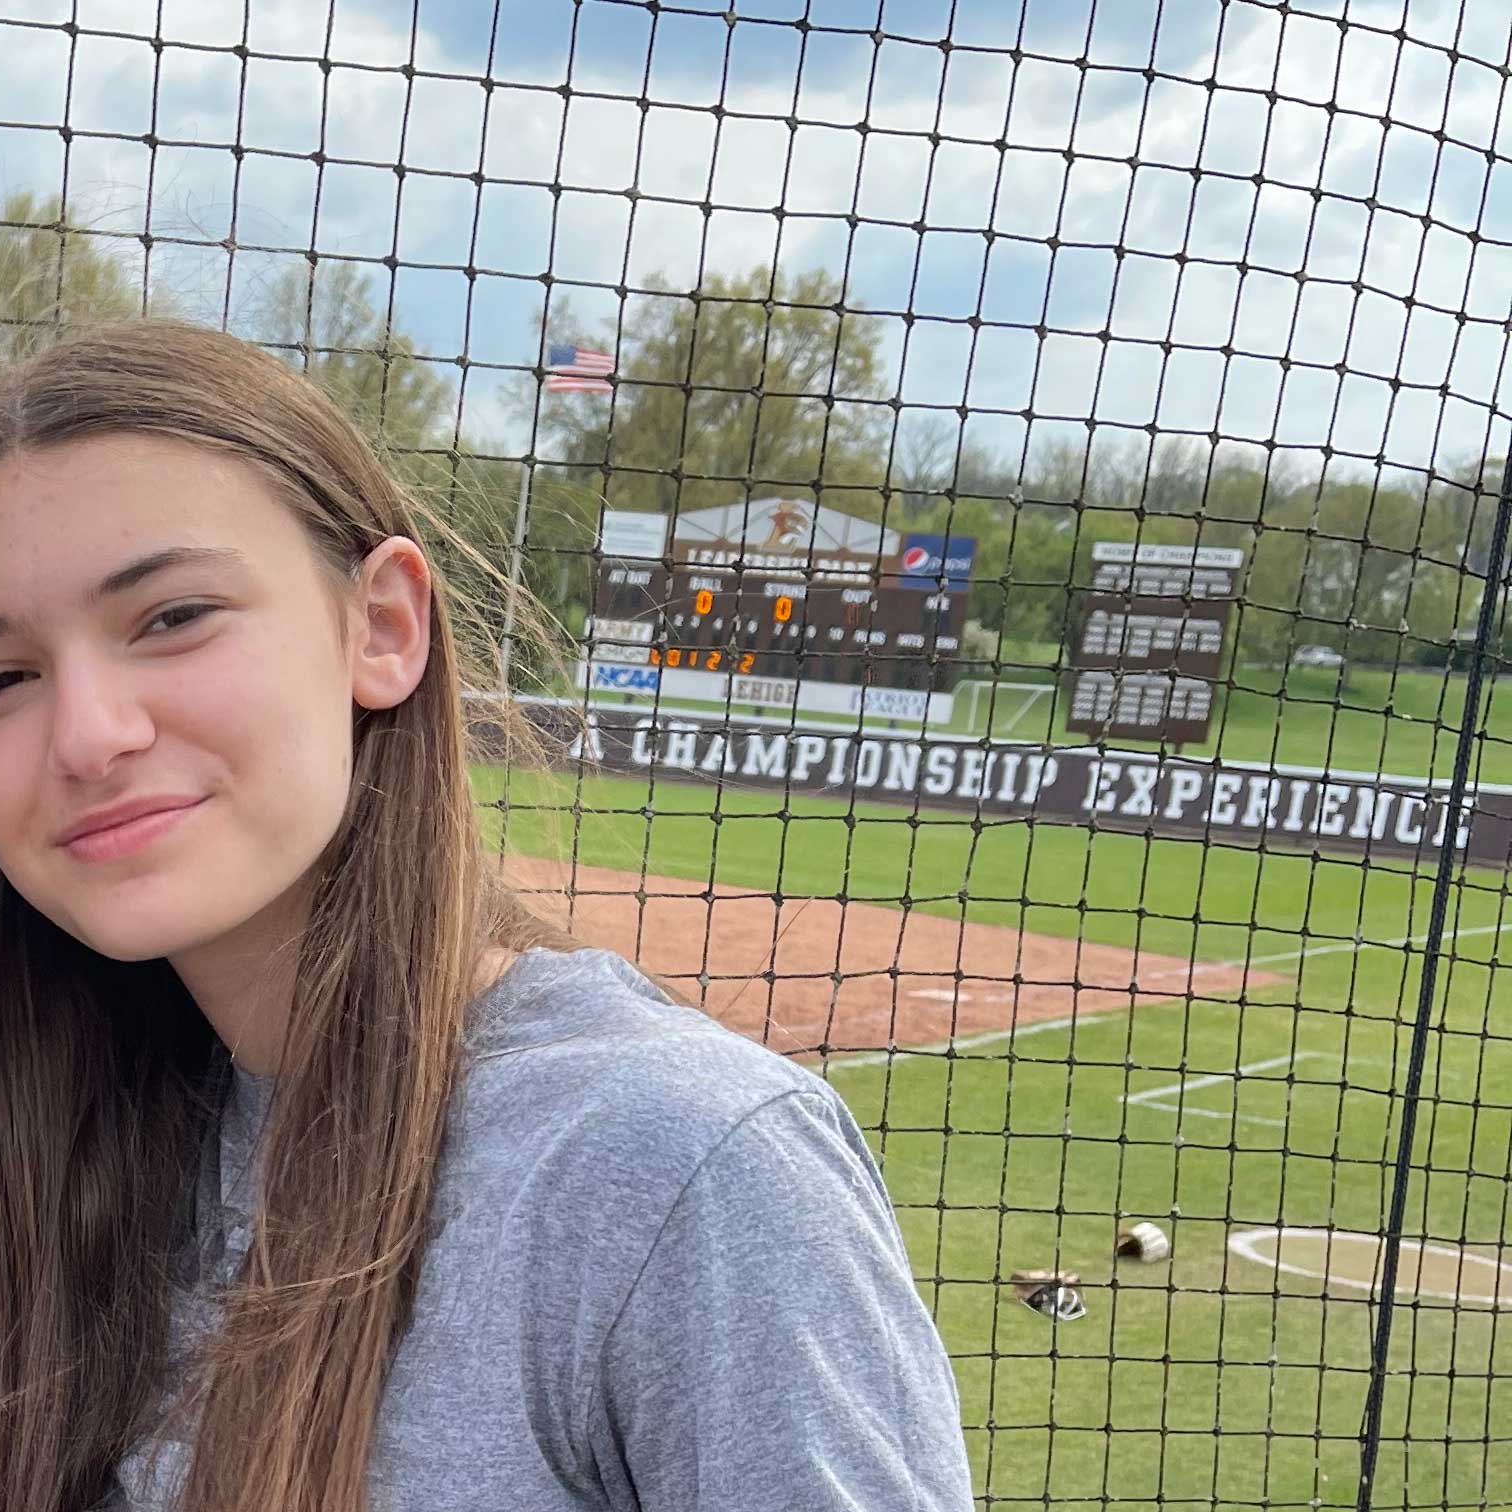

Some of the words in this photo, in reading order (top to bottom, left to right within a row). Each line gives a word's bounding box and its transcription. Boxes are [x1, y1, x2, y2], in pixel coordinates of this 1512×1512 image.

[696, 589, 713, 615] 0
[775, 596, 792, 622] 0
[841, 589, 873, 604] OUT
[706, 651, 721, 671] 2
[739, 653, 755, 674] 2
[596, 666, 658, 690] NCAA
[570, 714, 605, 760] A
[631, 718, 1059, 804] CHAMPIONSHIP
[1081, 760, 1479, 849] EXPERIENCE
